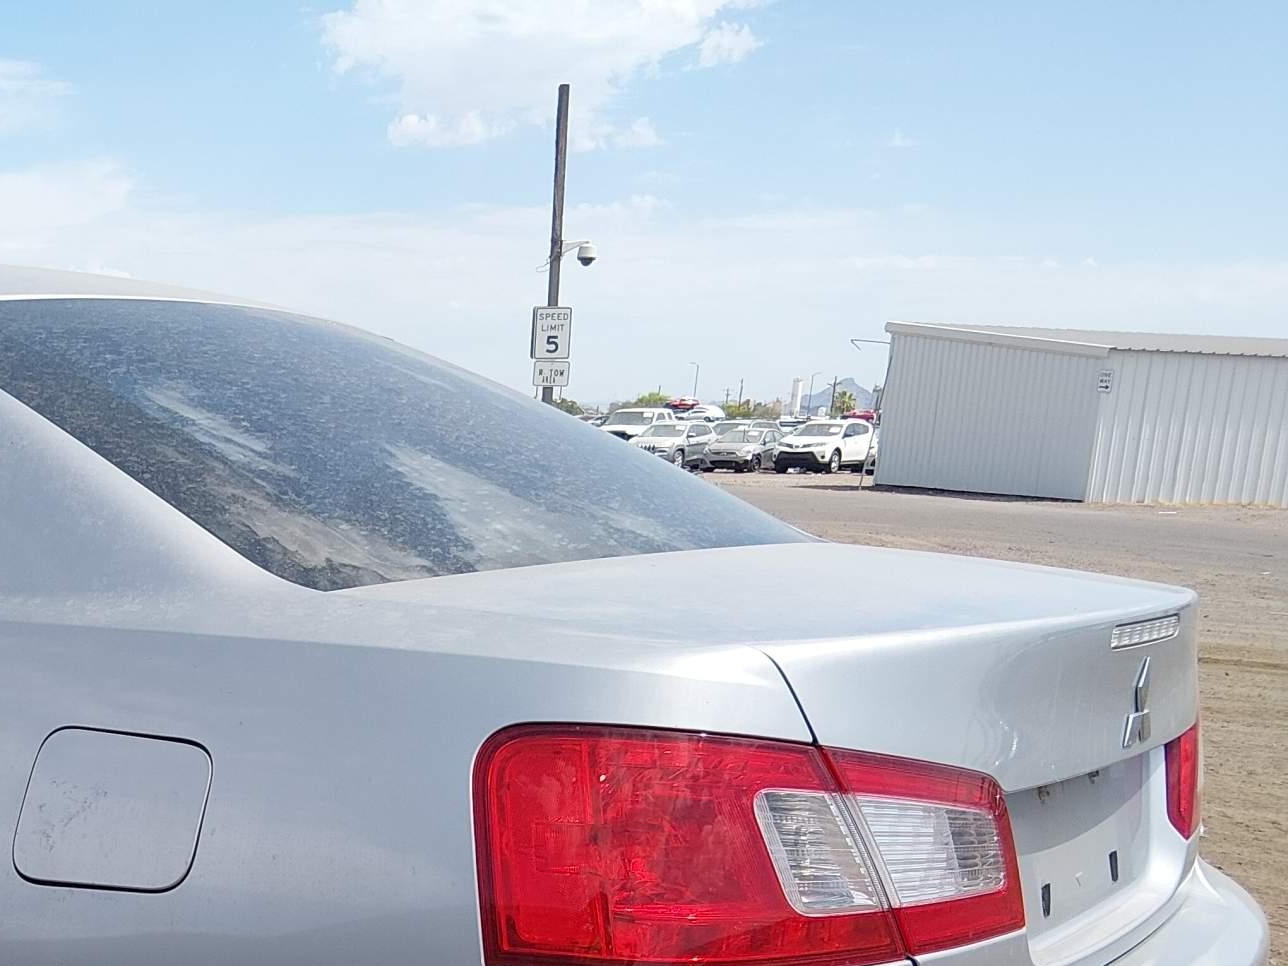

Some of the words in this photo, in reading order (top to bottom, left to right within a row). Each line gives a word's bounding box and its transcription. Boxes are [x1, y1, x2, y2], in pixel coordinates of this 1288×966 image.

[538, 312, 569, 321] SPEED
[541, 324, 565, 332] LIMIT
[545, 335, 559, 354] 5
[549, 368, 565, 377] TOW
